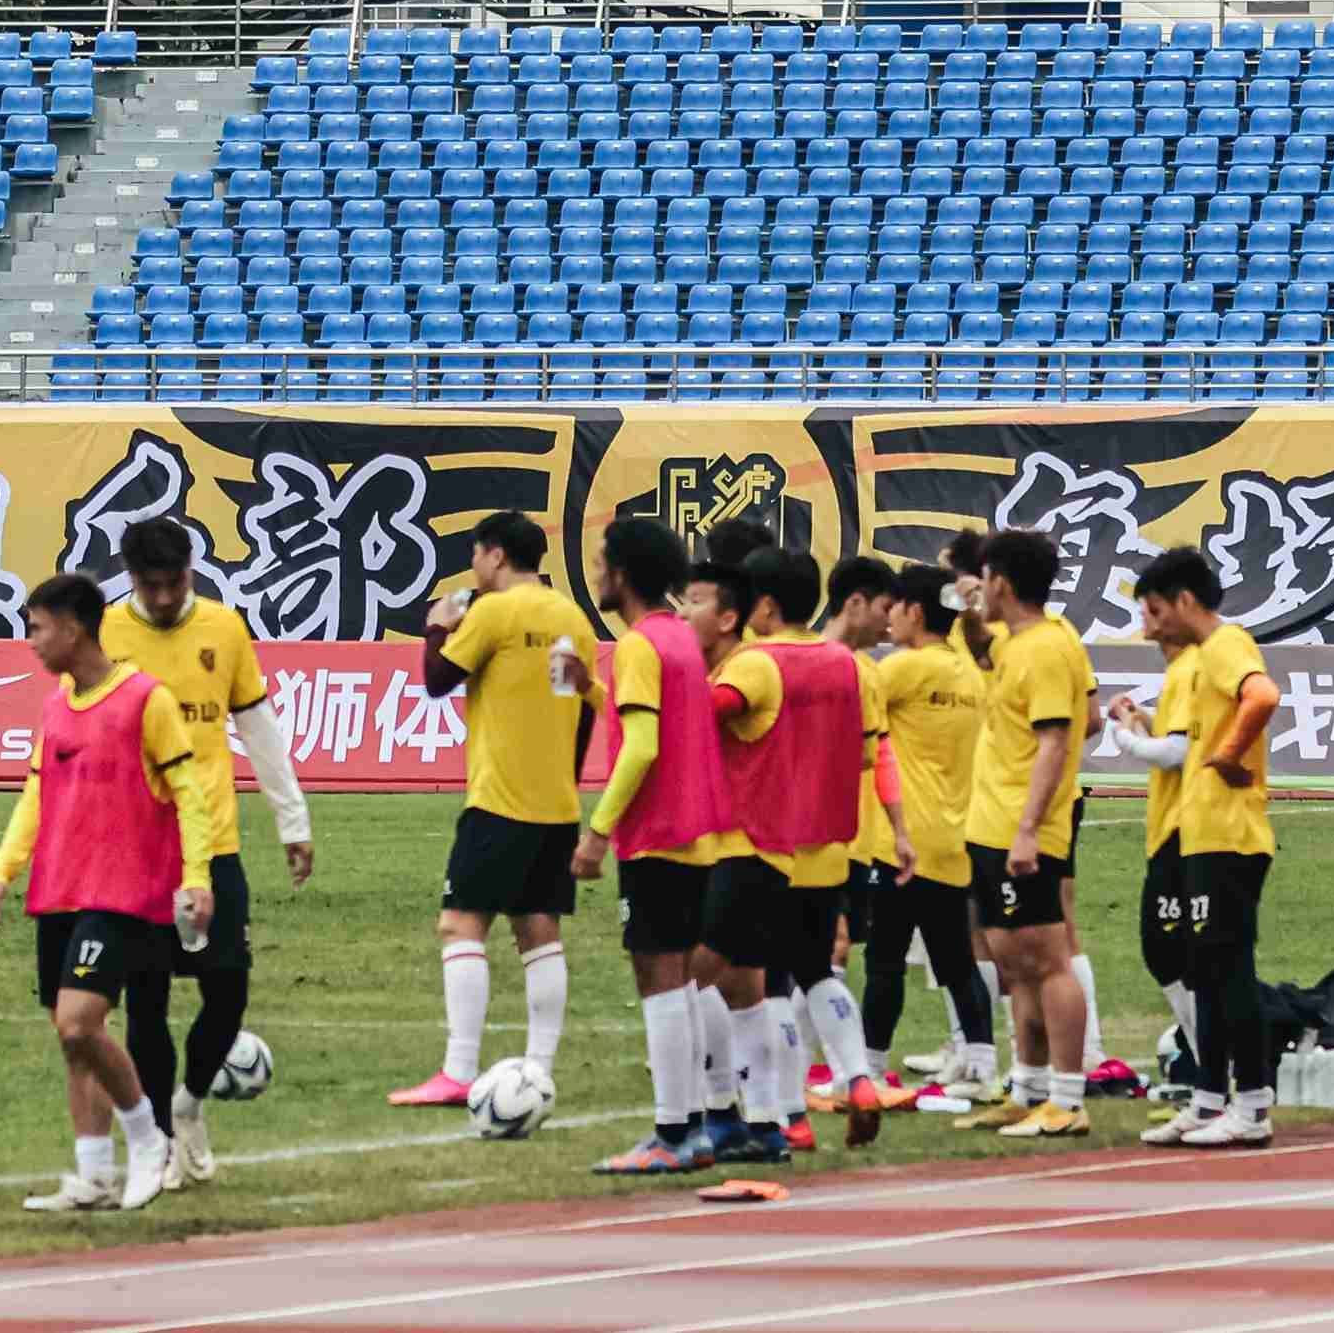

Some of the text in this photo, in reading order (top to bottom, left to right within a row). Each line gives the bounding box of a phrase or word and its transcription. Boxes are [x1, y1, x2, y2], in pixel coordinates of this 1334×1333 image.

[1001, 881, 1017, 905] 5
[1157, 896, 1182, 919] 26
[78, 939, 104, 966] 17
